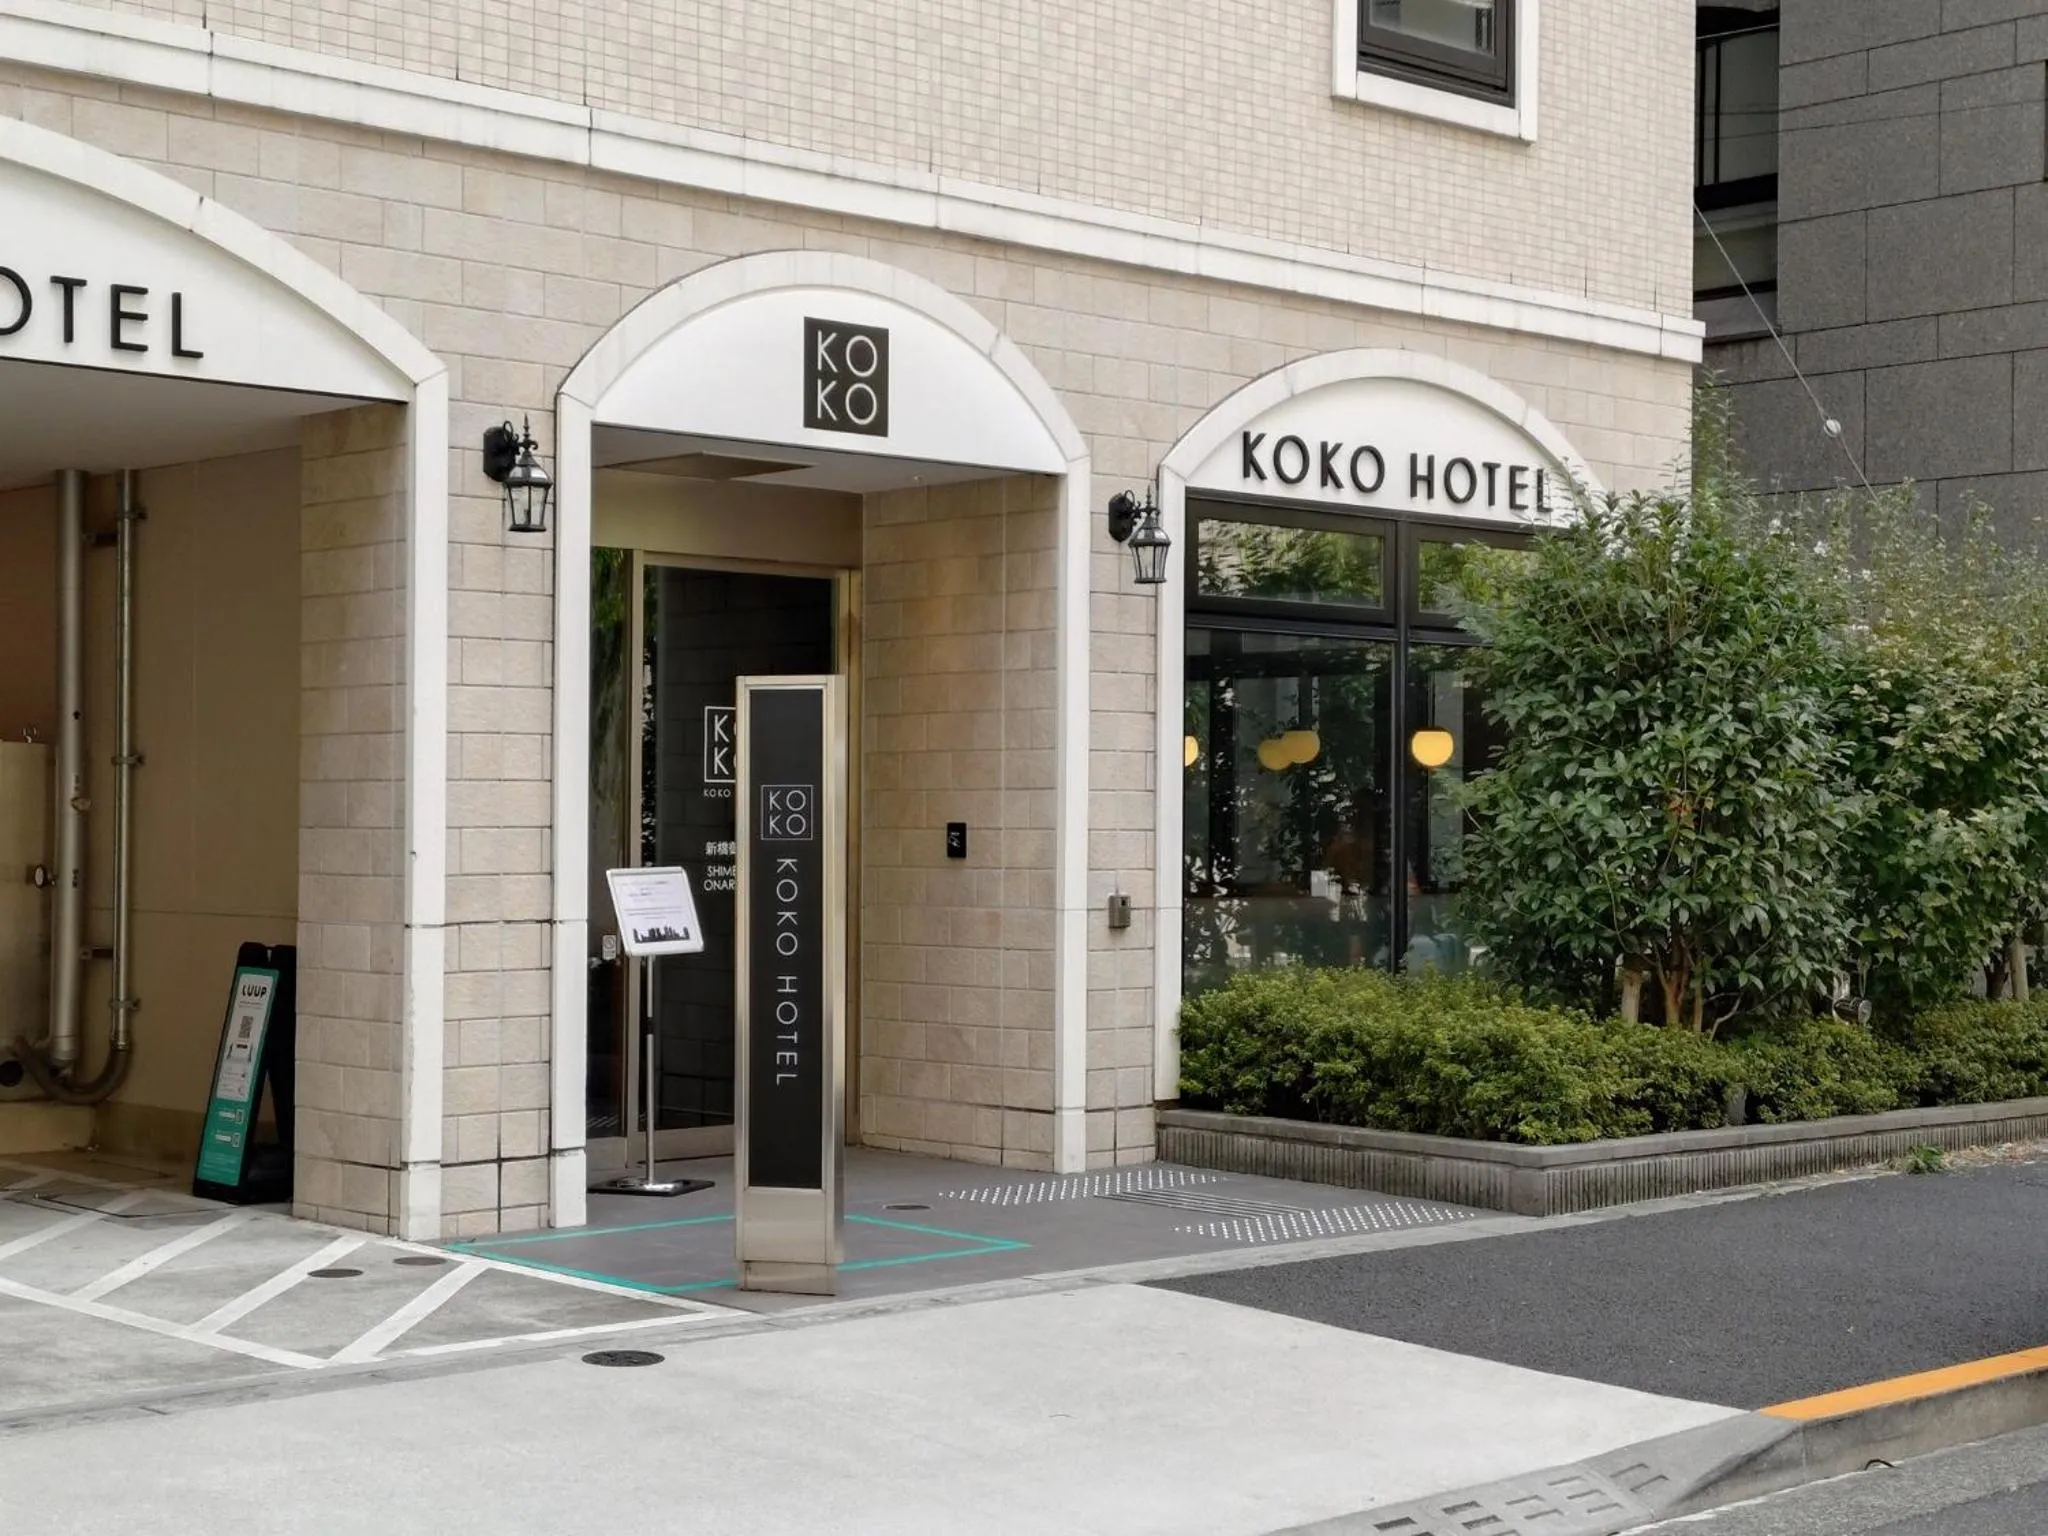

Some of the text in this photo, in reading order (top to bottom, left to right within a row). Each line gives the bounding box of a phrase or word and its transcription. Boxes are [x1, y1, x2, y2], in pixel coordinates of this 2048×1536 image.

[817, 329, 878, 378] KO
[817, 377, 878, 425] KO
[1242, 430, 1554, 514] KOKO HOTEL
[714, 714, 736, 743] K
[714, 746, 736, 775] K
[703, 788, 731, 797] KOKO
[769, 790, 806, 811] KO
[769, 813, 806, 835] KO
[776, 858, 798, 1086] KOKO HOTEL
[242, 984, 267, 998] LUUP
